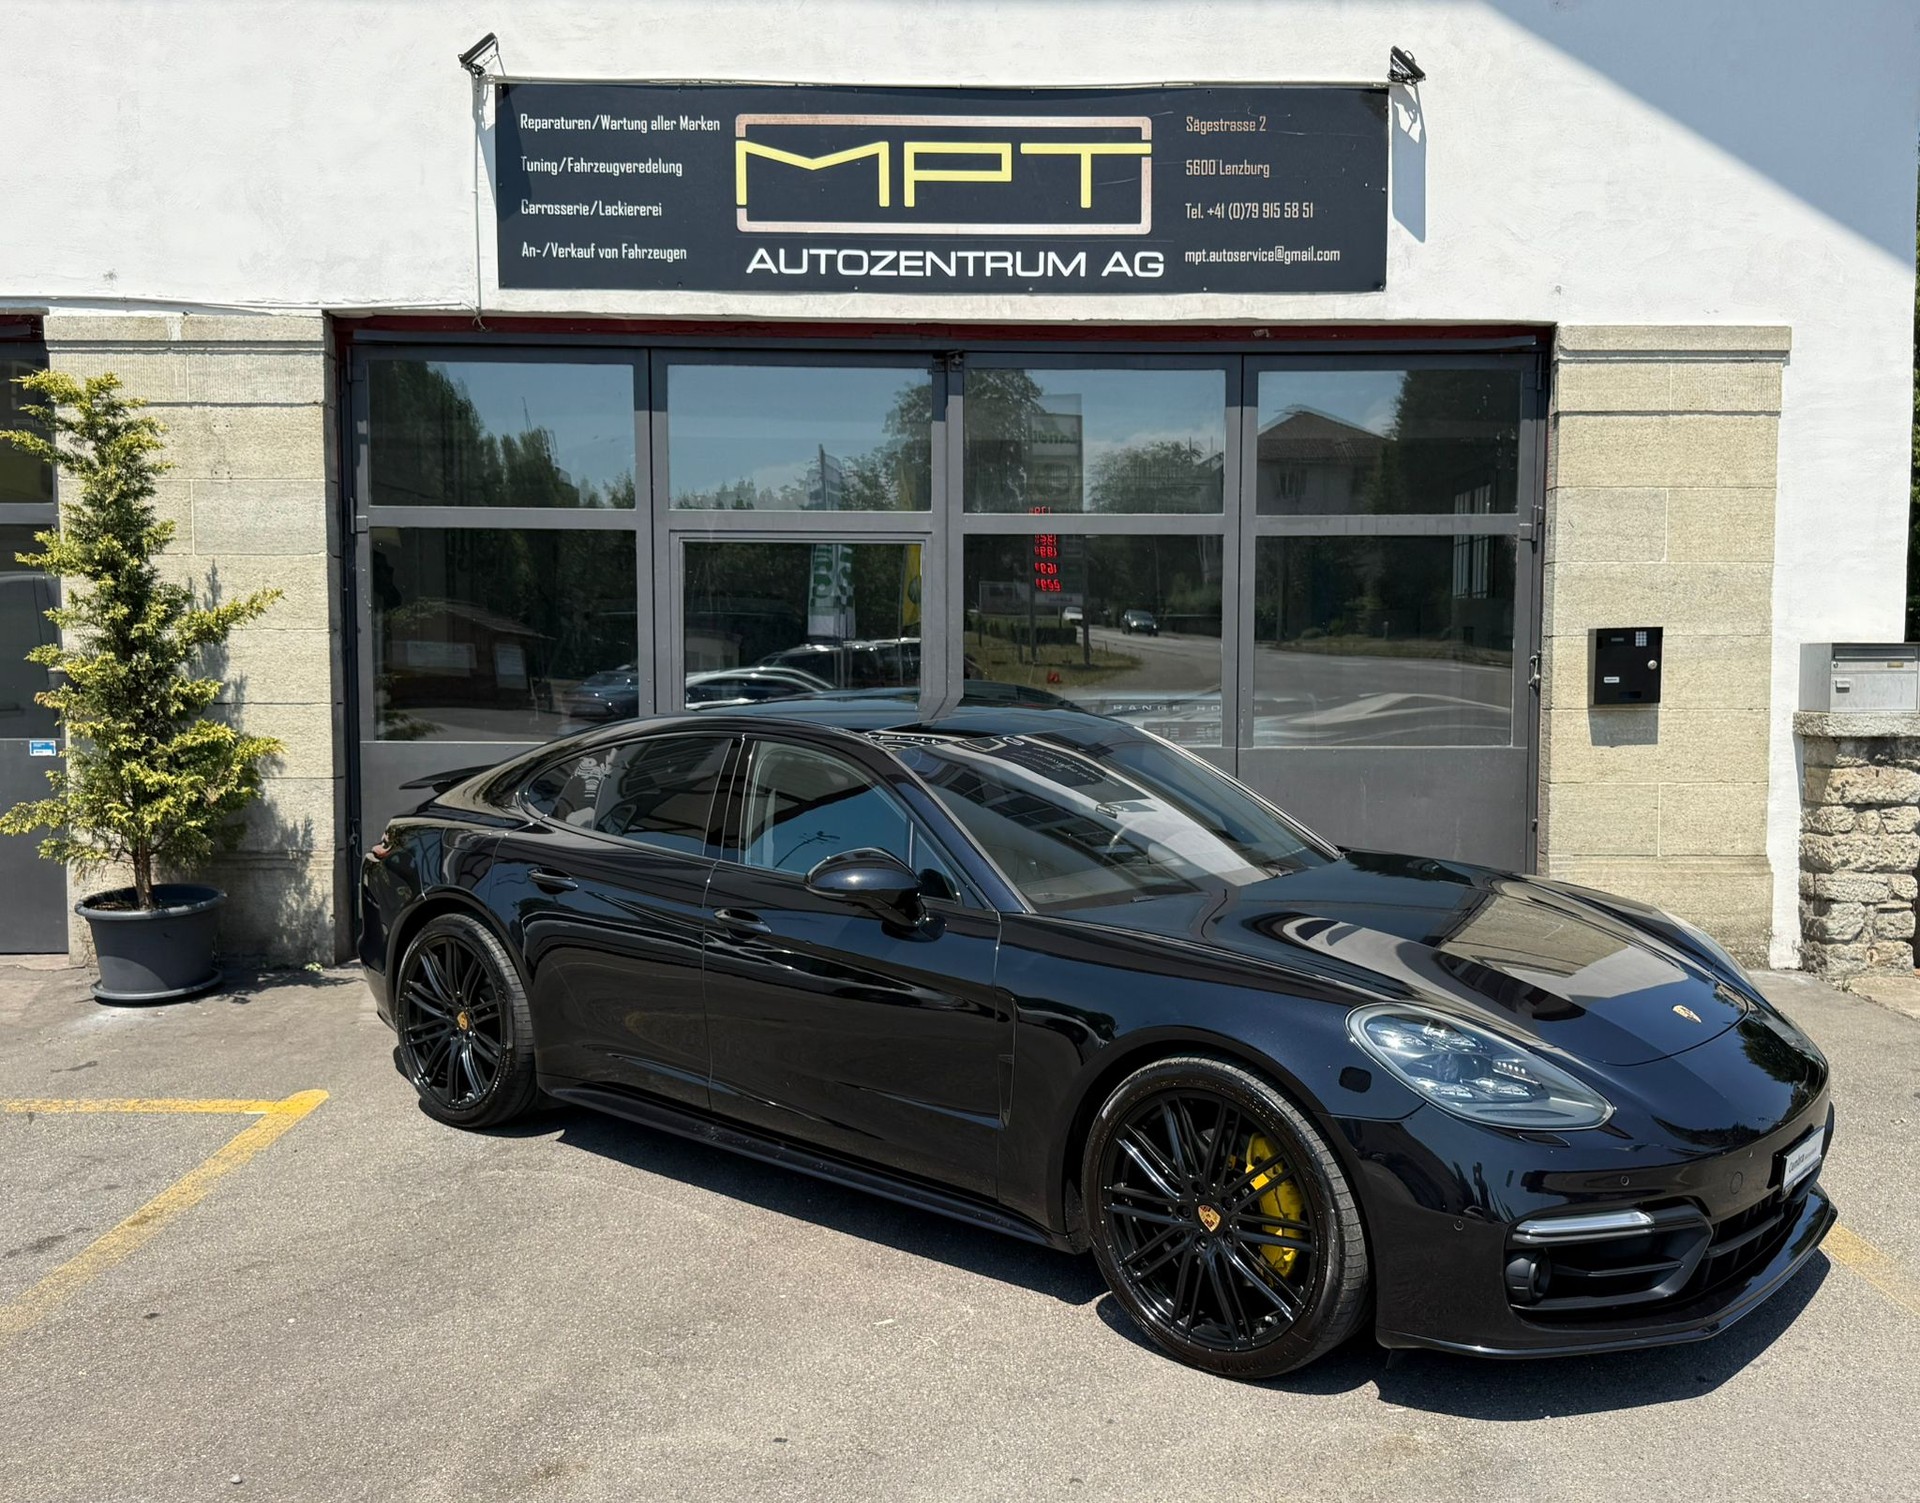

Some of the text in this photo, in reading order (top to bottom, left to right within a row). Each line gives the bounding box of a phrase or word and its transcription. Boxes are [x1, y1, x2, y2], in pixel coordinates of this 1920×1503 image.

[520, 114, 721, 133] Reparaturen/Wartung aller Marken
[1185, 115, 1267, 134] Sägestrasse 2
[520, 156, 683, 177] Tuning/Fahrzeugveredelung
[736, 140, 1152, 209] MPT
[1185, 160, 1270, 179] 5600 Lenzburg
[520, 199, 663, 217] Carrosserie/Lackiererei
[1185, 202, 1314, 220] Tel. +41 (0)79 915 58 51
[521, 242, 687, 263] An-/Verkauf von Fahrzeugen
[746, 246, 1165, 278] AUTOZENTRUM AG
[1184, 246, 1341, 266] mpt.autoservice@gmail.com
